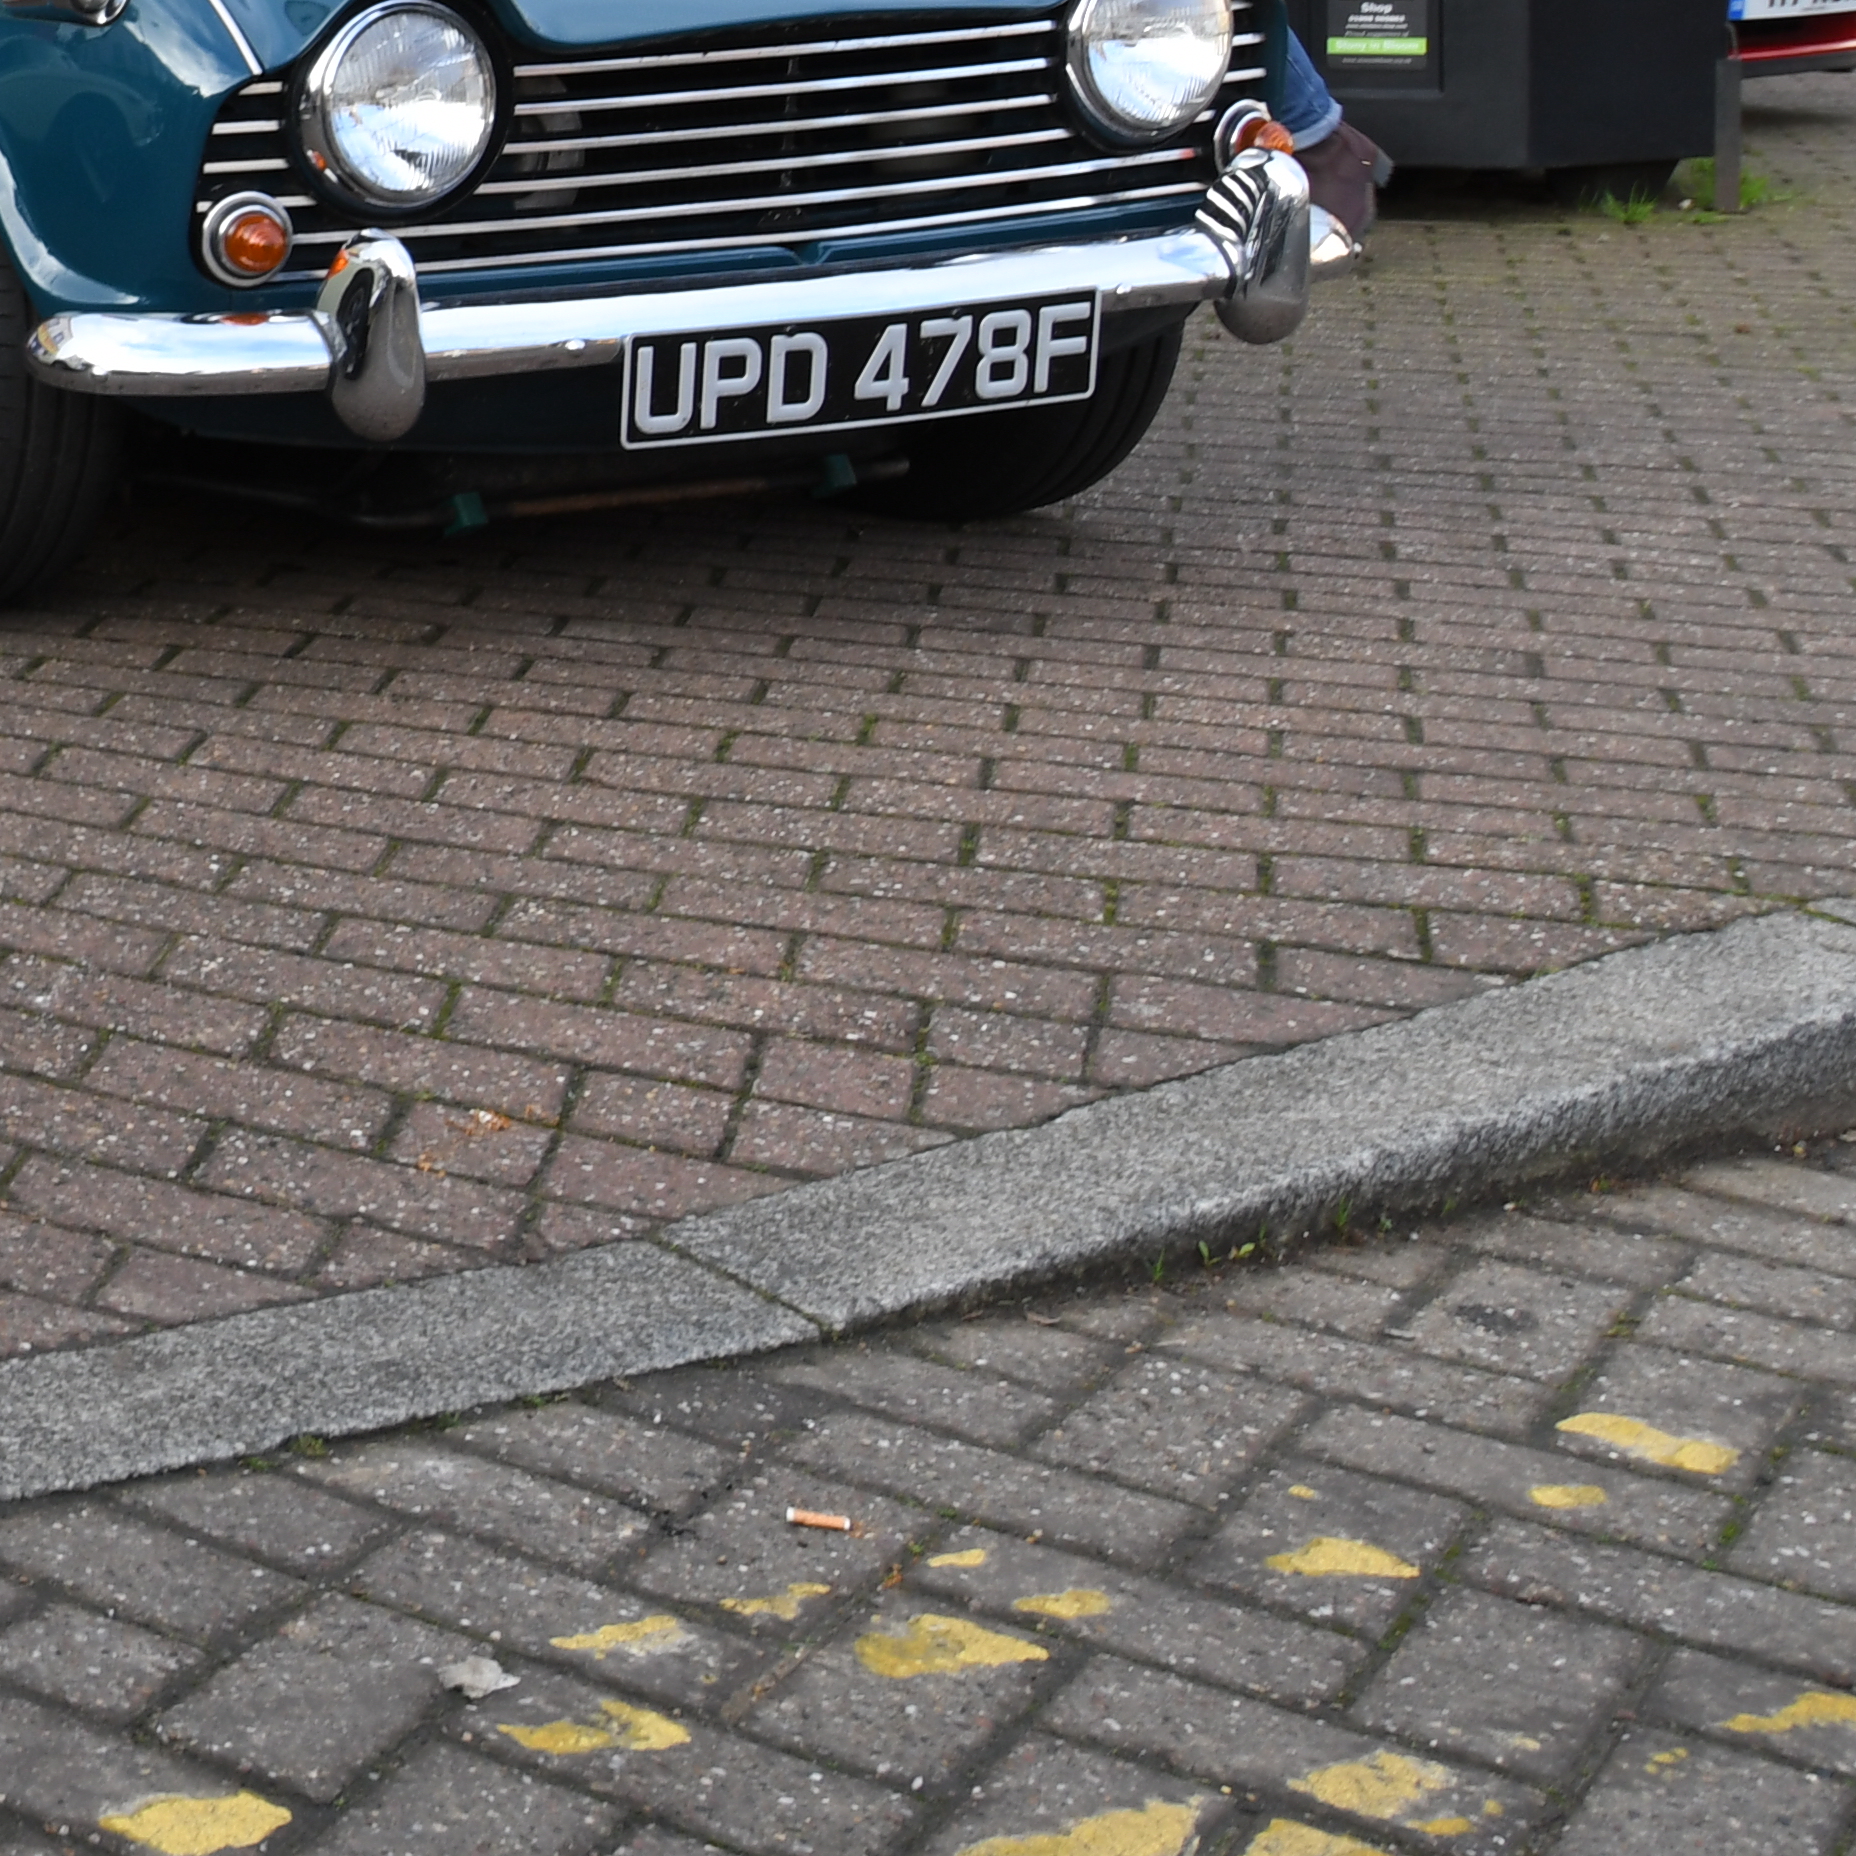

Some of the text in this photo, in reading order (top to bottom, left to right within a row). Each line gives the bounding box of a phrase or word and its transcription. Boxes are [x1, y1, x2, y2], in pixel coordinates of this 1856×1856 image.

[1360, 1, 1393, 14] Shop
[634, 300, 1092, 434] UPD 478F
